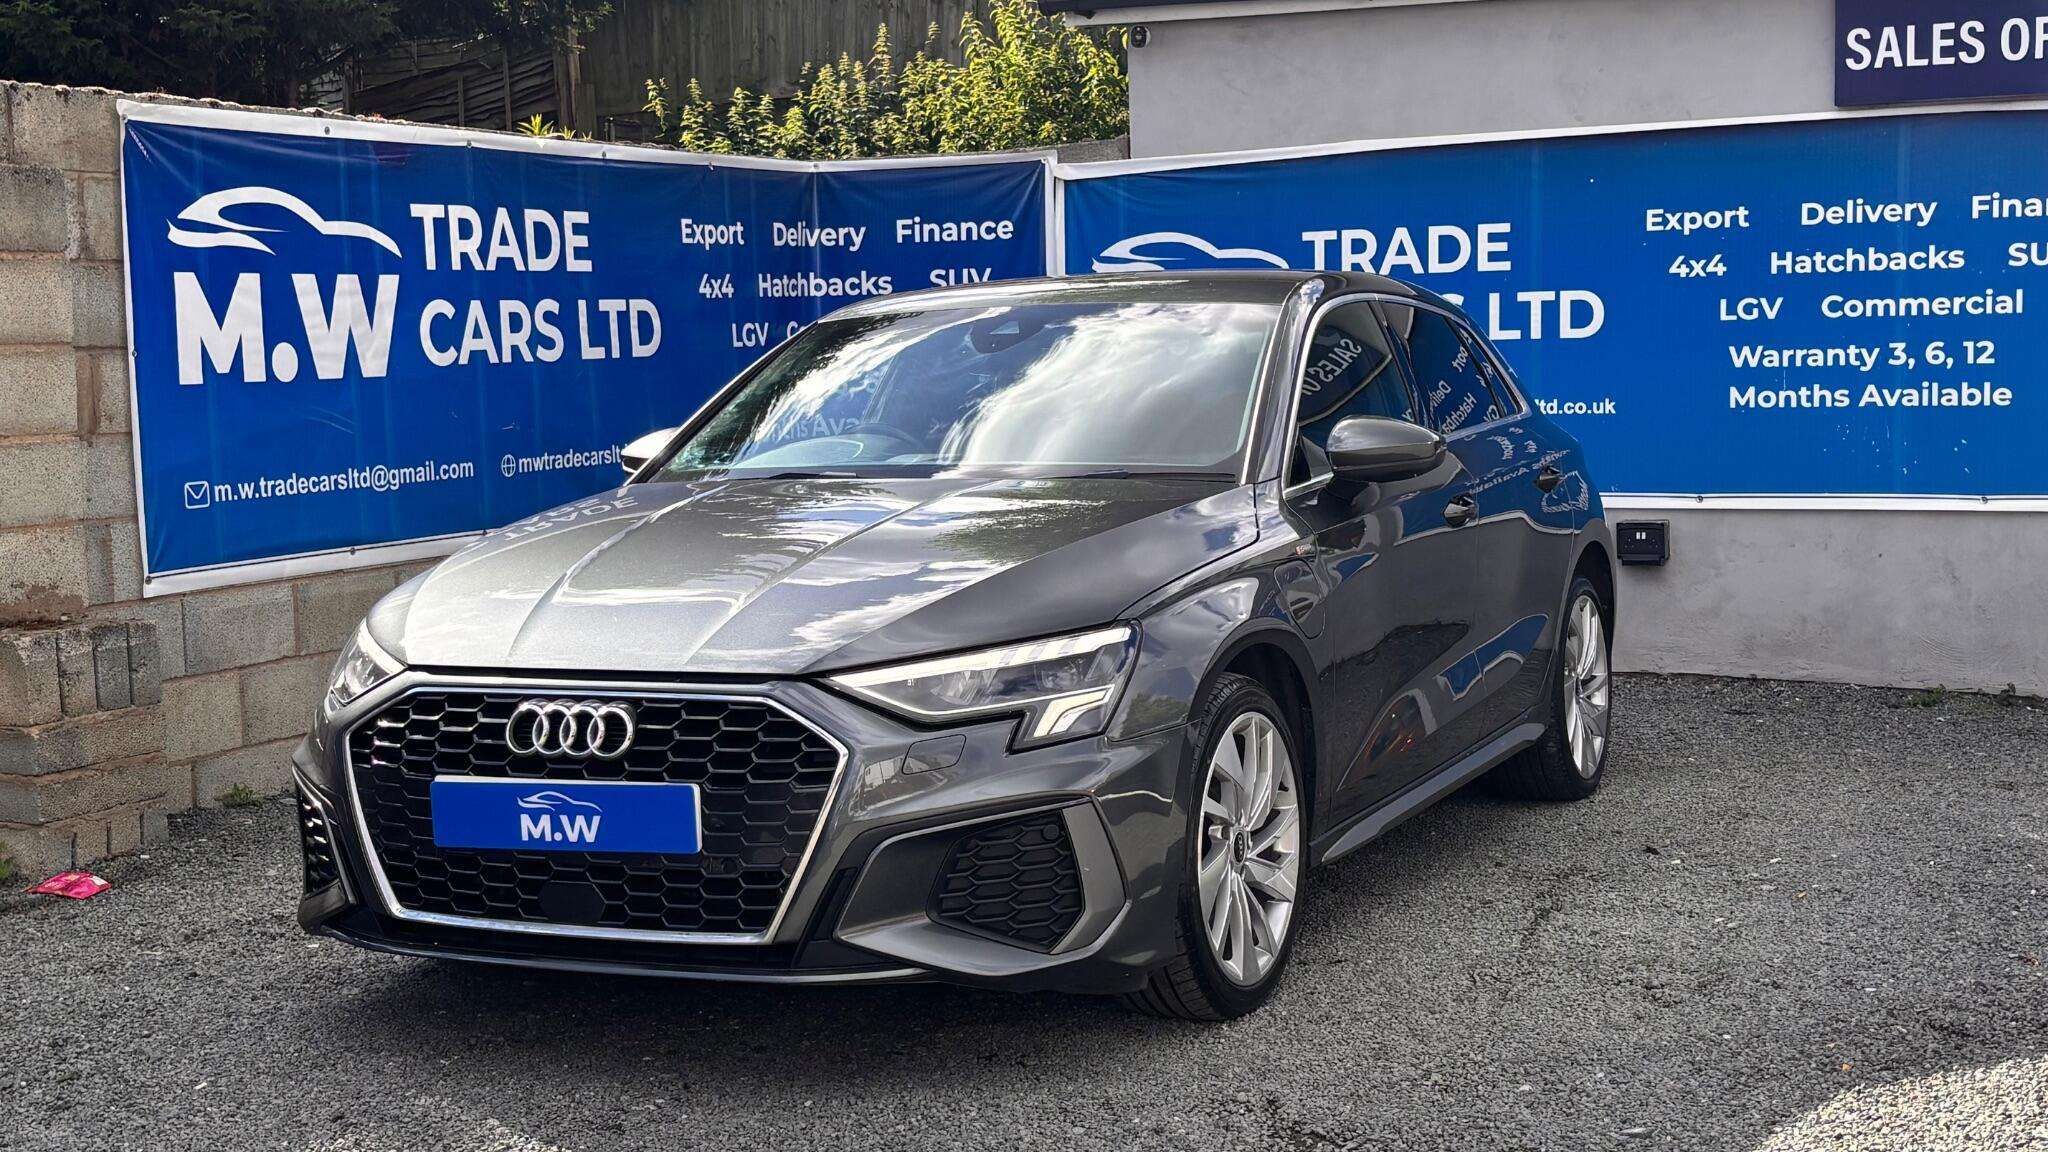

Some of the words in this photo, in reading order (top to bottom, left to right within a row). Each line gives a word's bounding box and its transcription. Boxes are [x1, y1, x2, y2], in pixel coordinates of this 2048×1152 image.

[1845, 20, 1986, 71] SALES
[1646, 205, 1750, 235] Export
[1801, 199, 1938, 227] Delivery
[1971, 192, 2048, 219] Fina
[410, 203, 593, 272] TRADE
[681, 218, 744, 251] Export
[773, 222, 866, 252] Delivery
[897, 217, 1014, 244] Finance
[1302, 222, 1512, 276] TRADE
[1669, 254, 1727, 278] 4x4
[1770, 245, 1965, 275] Hatchbacks
[699, 273, 734, 299] 4x4
[758, 271, 893, 298] Hatchbacks
[1488, 290, 1605, 341] LTD
[1719, 297, 1784, 321] LGV
[1821, 289, 2024, 319] Commercial
[173, 271, 400, 386] M.W
[419, 299, 565, 367] CARS
[579, 299, 662, 361] LTD
[731, 322, 769, 348] LGV
[1728, 346, 1881, 372] Warranty
[1888, 343, 1916, 370] 3,
[1925, 342, 1955, 370] 6,
[1963, 341, 1996, 365] 12
[1729, 385, 1851, 409] Months
[1859, 382, 2013, 408] Available
[518, 443, 628, 474] mwtradecarslt
[213, 459, 475, 504] m.w.tradecarsltd@gmail.com
[520, 813, 602, 843] M.W
